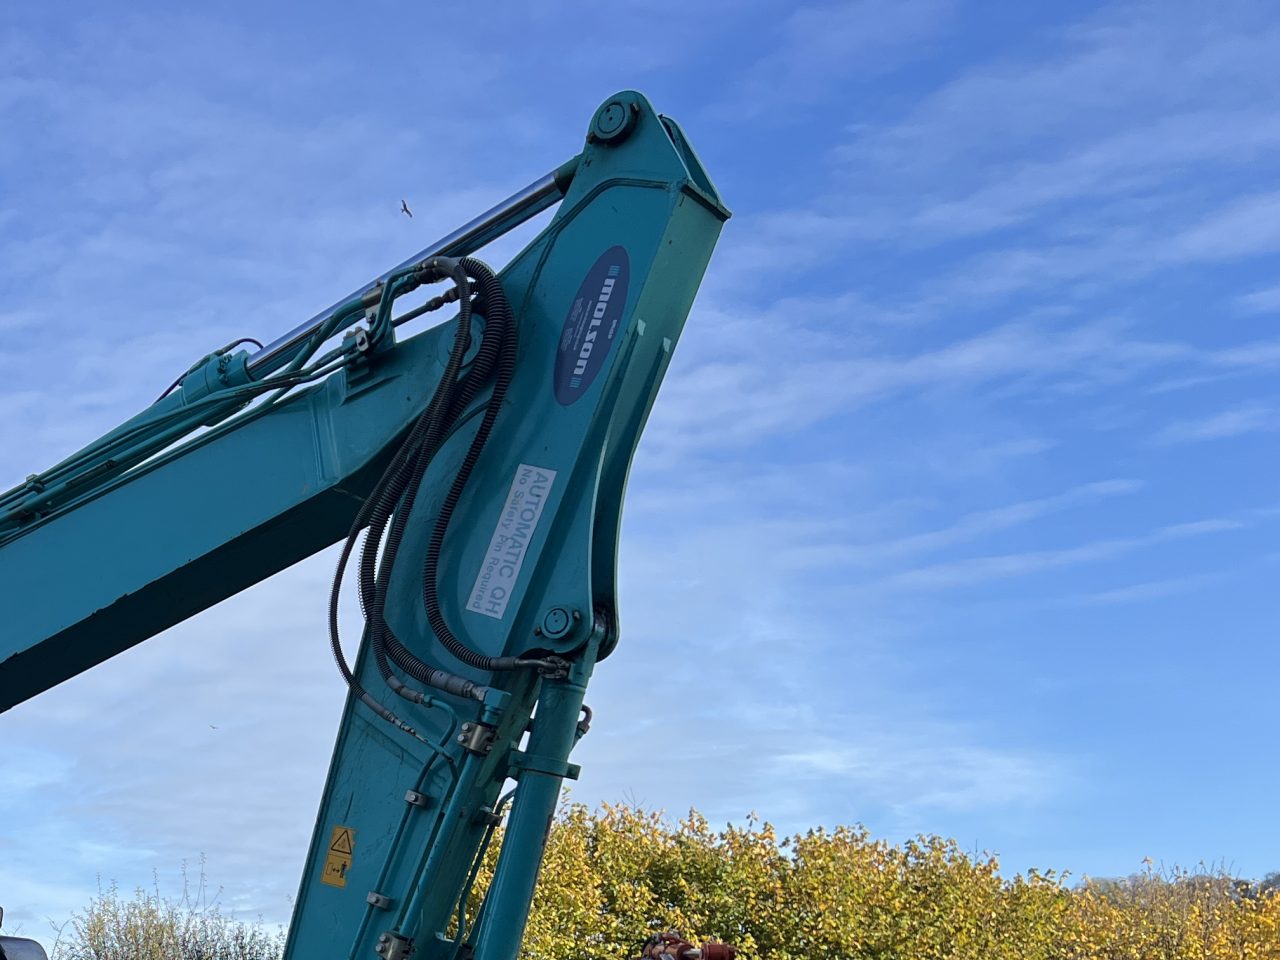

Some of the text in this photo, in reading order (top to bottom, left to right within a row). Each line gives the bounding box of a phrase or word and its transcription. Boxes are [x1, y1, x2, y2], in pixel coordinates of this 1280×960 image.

[472, 469, 533, 609] No Safety Pin Required
[485, 472, 548, 614] AUTOMATIC QH
